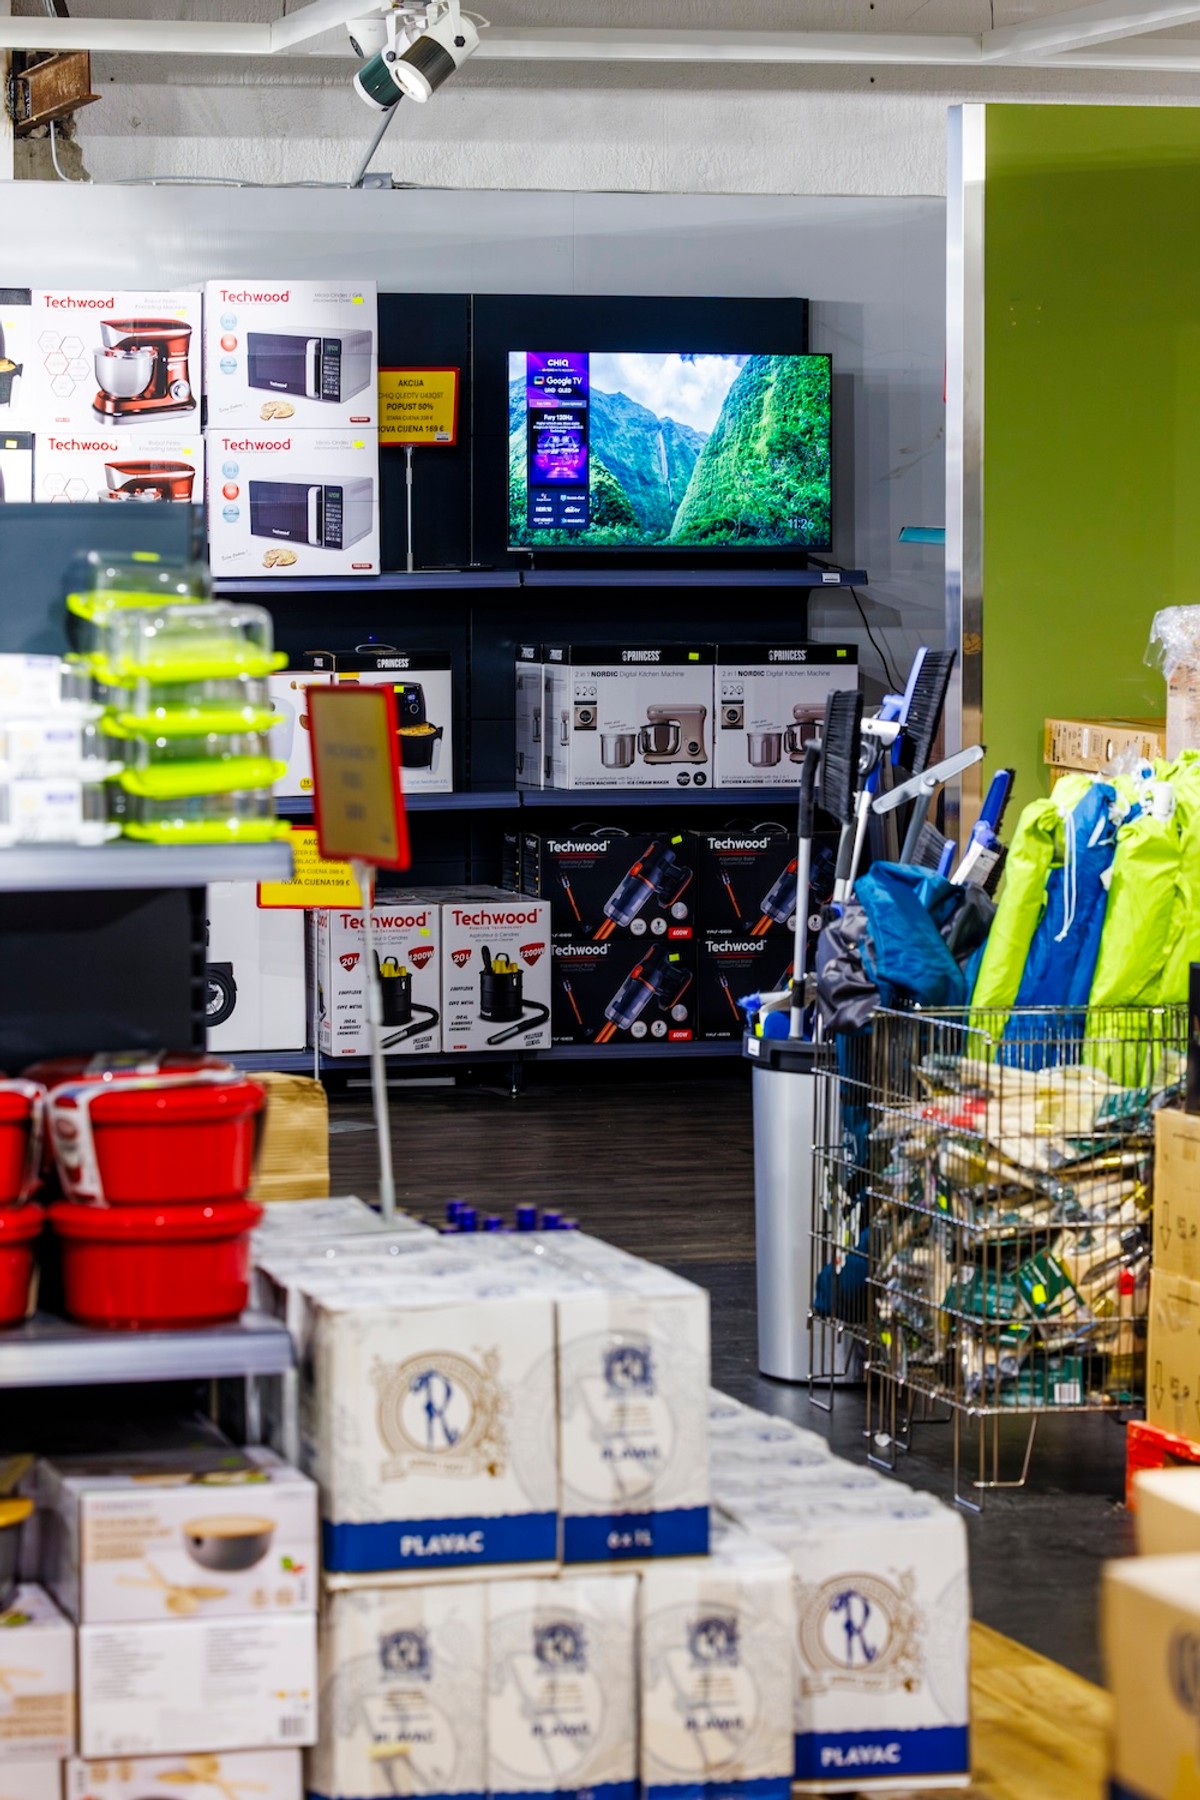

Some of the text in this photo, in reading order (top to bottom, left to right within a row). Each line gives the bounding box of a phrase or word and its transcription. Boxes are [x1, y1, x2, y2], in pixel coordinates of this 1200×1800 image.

[44, 296, 114, 309] Techwood
[220, 290, 289, 303] Techwood
[398, 379, 424, 387] AKCIJA
[546, 376, 572, 386] Google
[48, 438, 118, 451] Techwood
[222, 439, 291, 450] Techwood
[788, 518, 815, 530] 11:26
[627, 651, 661, 662] PRINCESS
[774, 650, 806, 661] PRINCESS
[381, 658, 410, 668] PRINCESS
[619, 671, 637, 679] Digital
[766, 670, 783, 678] Digital
[547, 840, 607, 853] Techwood
[707, 837, 767, 849] Techwood
[452, 909, 537, 926] Techwood
[552, 941, 609, 955] Techwood
[705, 940, 765, 952] Techwood
[409, 950, 434, 962] 1200W
[520, 947, 546, 959] 1200W
[400, 1530, 484, 1557] PLAVAC
[820, 1743, 901, 1768] PLAVAC
